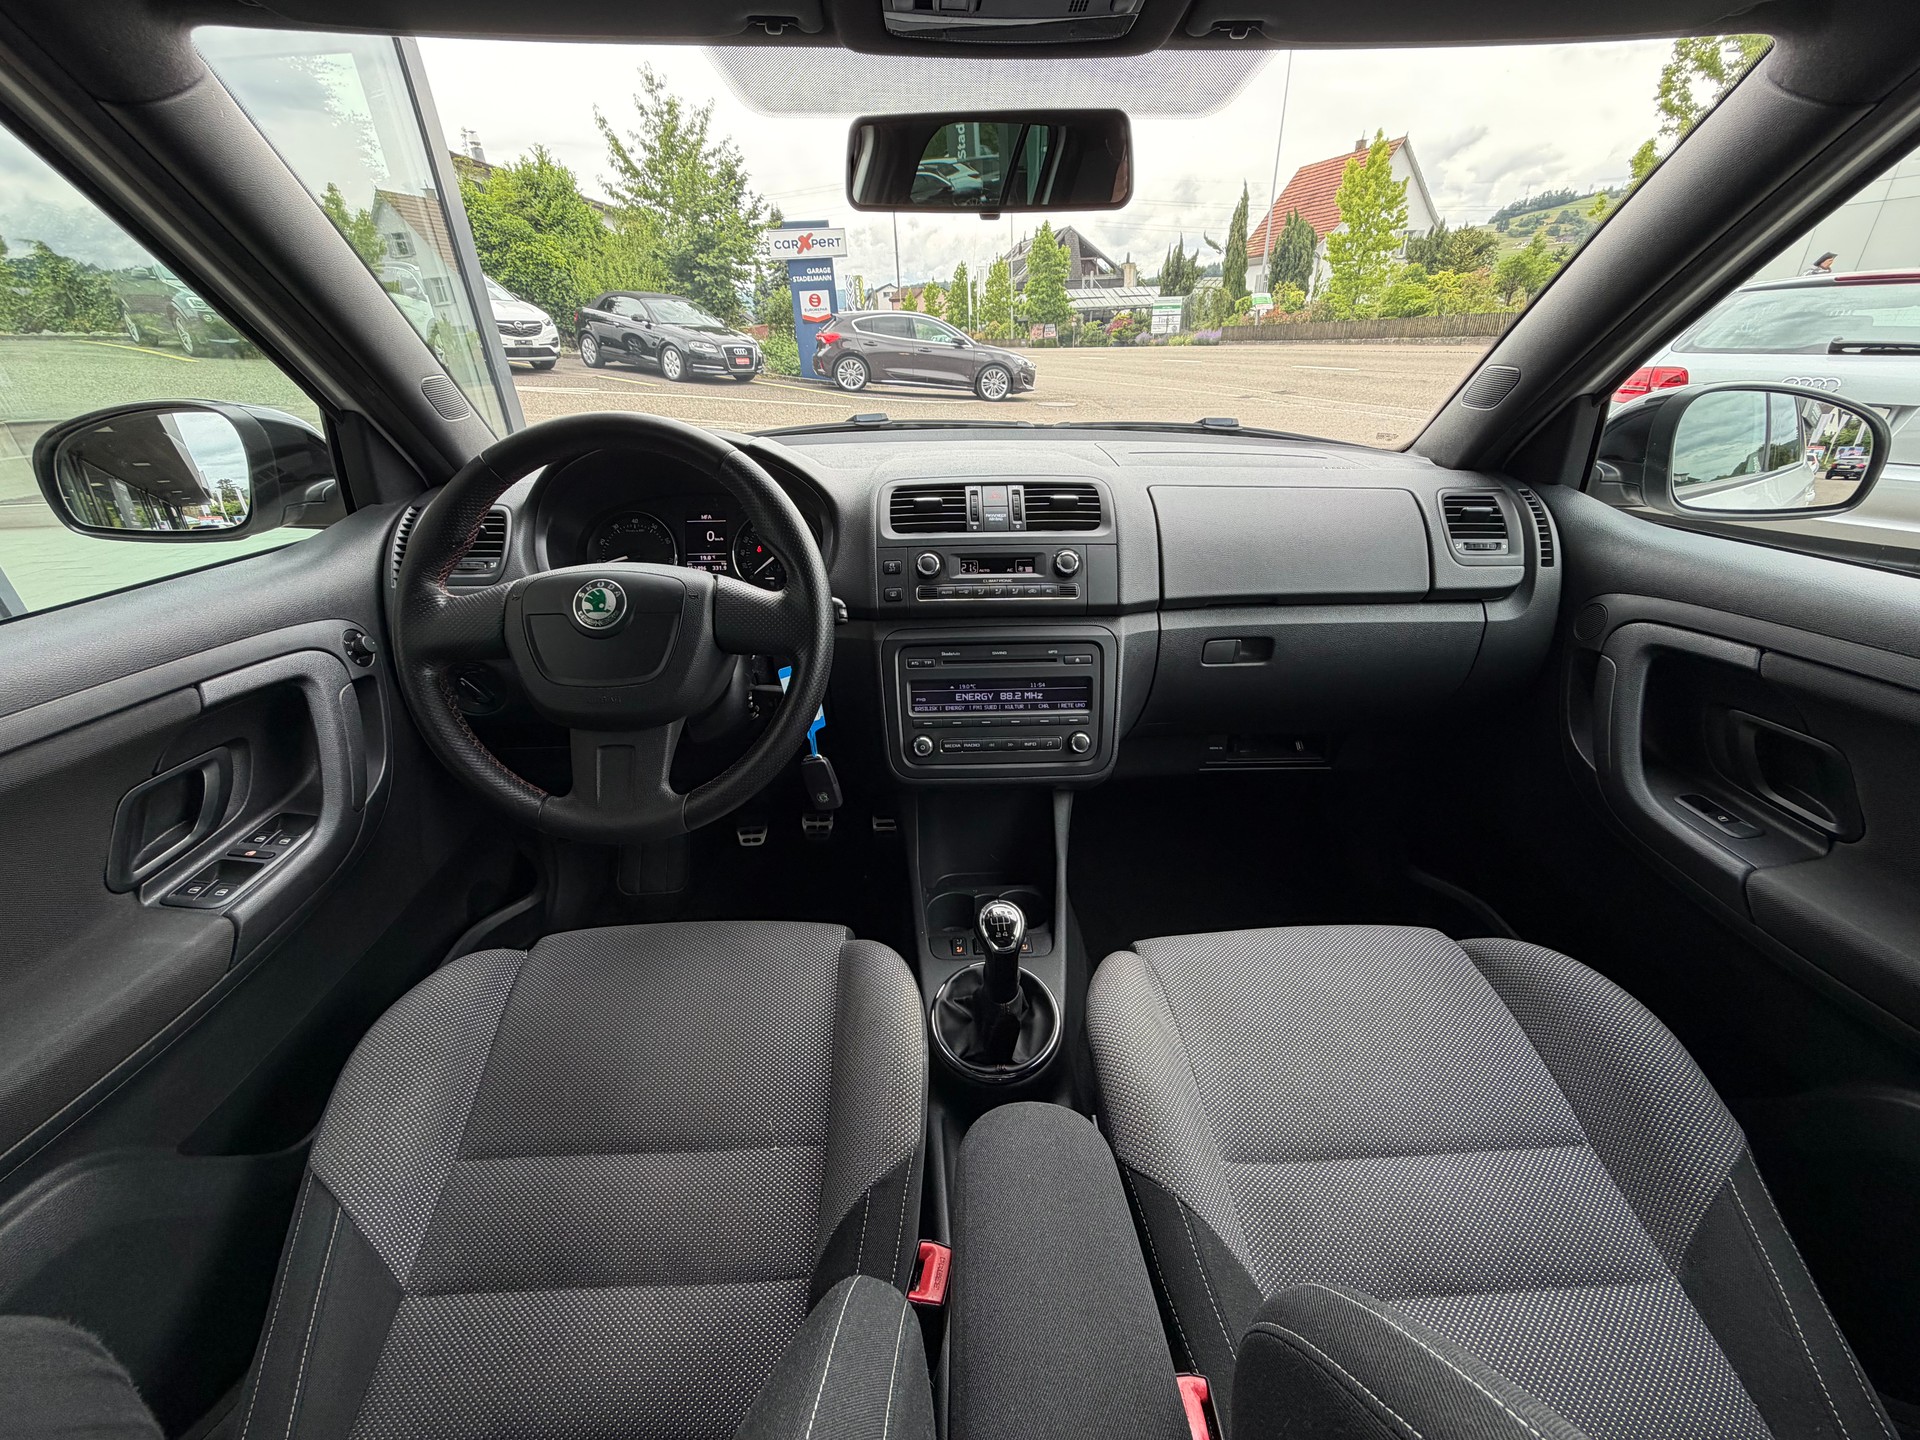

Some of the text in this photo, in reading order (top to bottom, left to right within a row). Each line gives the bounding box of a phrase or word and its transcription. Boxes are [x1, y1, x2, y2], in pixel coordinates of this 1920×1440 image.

[706, 530, 715, 542] 0
[955, 691, 1043, 701] ENERGY 88.2 MHz
